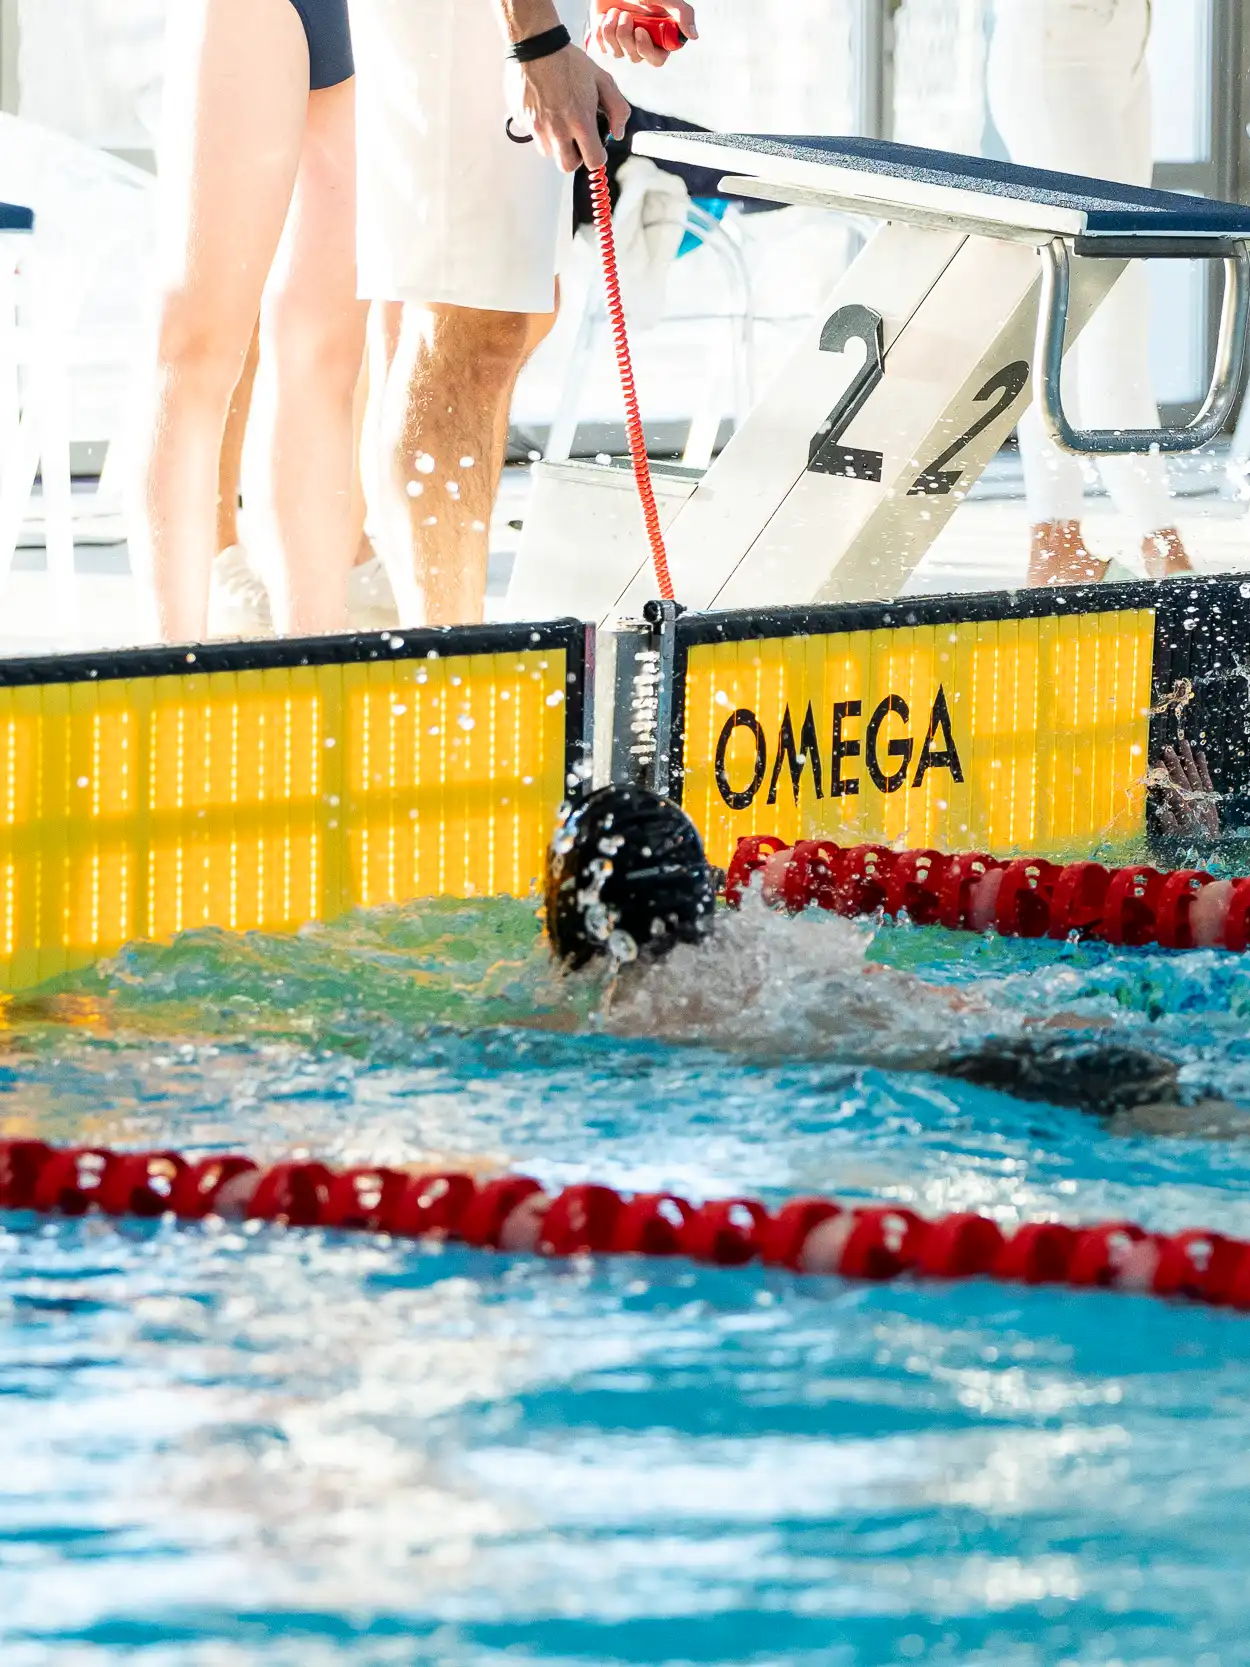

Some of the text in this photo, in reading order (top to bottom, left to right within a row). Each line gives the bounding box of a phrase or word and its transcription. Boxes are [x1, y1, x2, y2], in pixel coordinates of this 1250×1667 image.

[804, 304, 885, 483] 2
[906, 360, 1030, 496] 2
[715, 683, 964, 810] OMEGA
